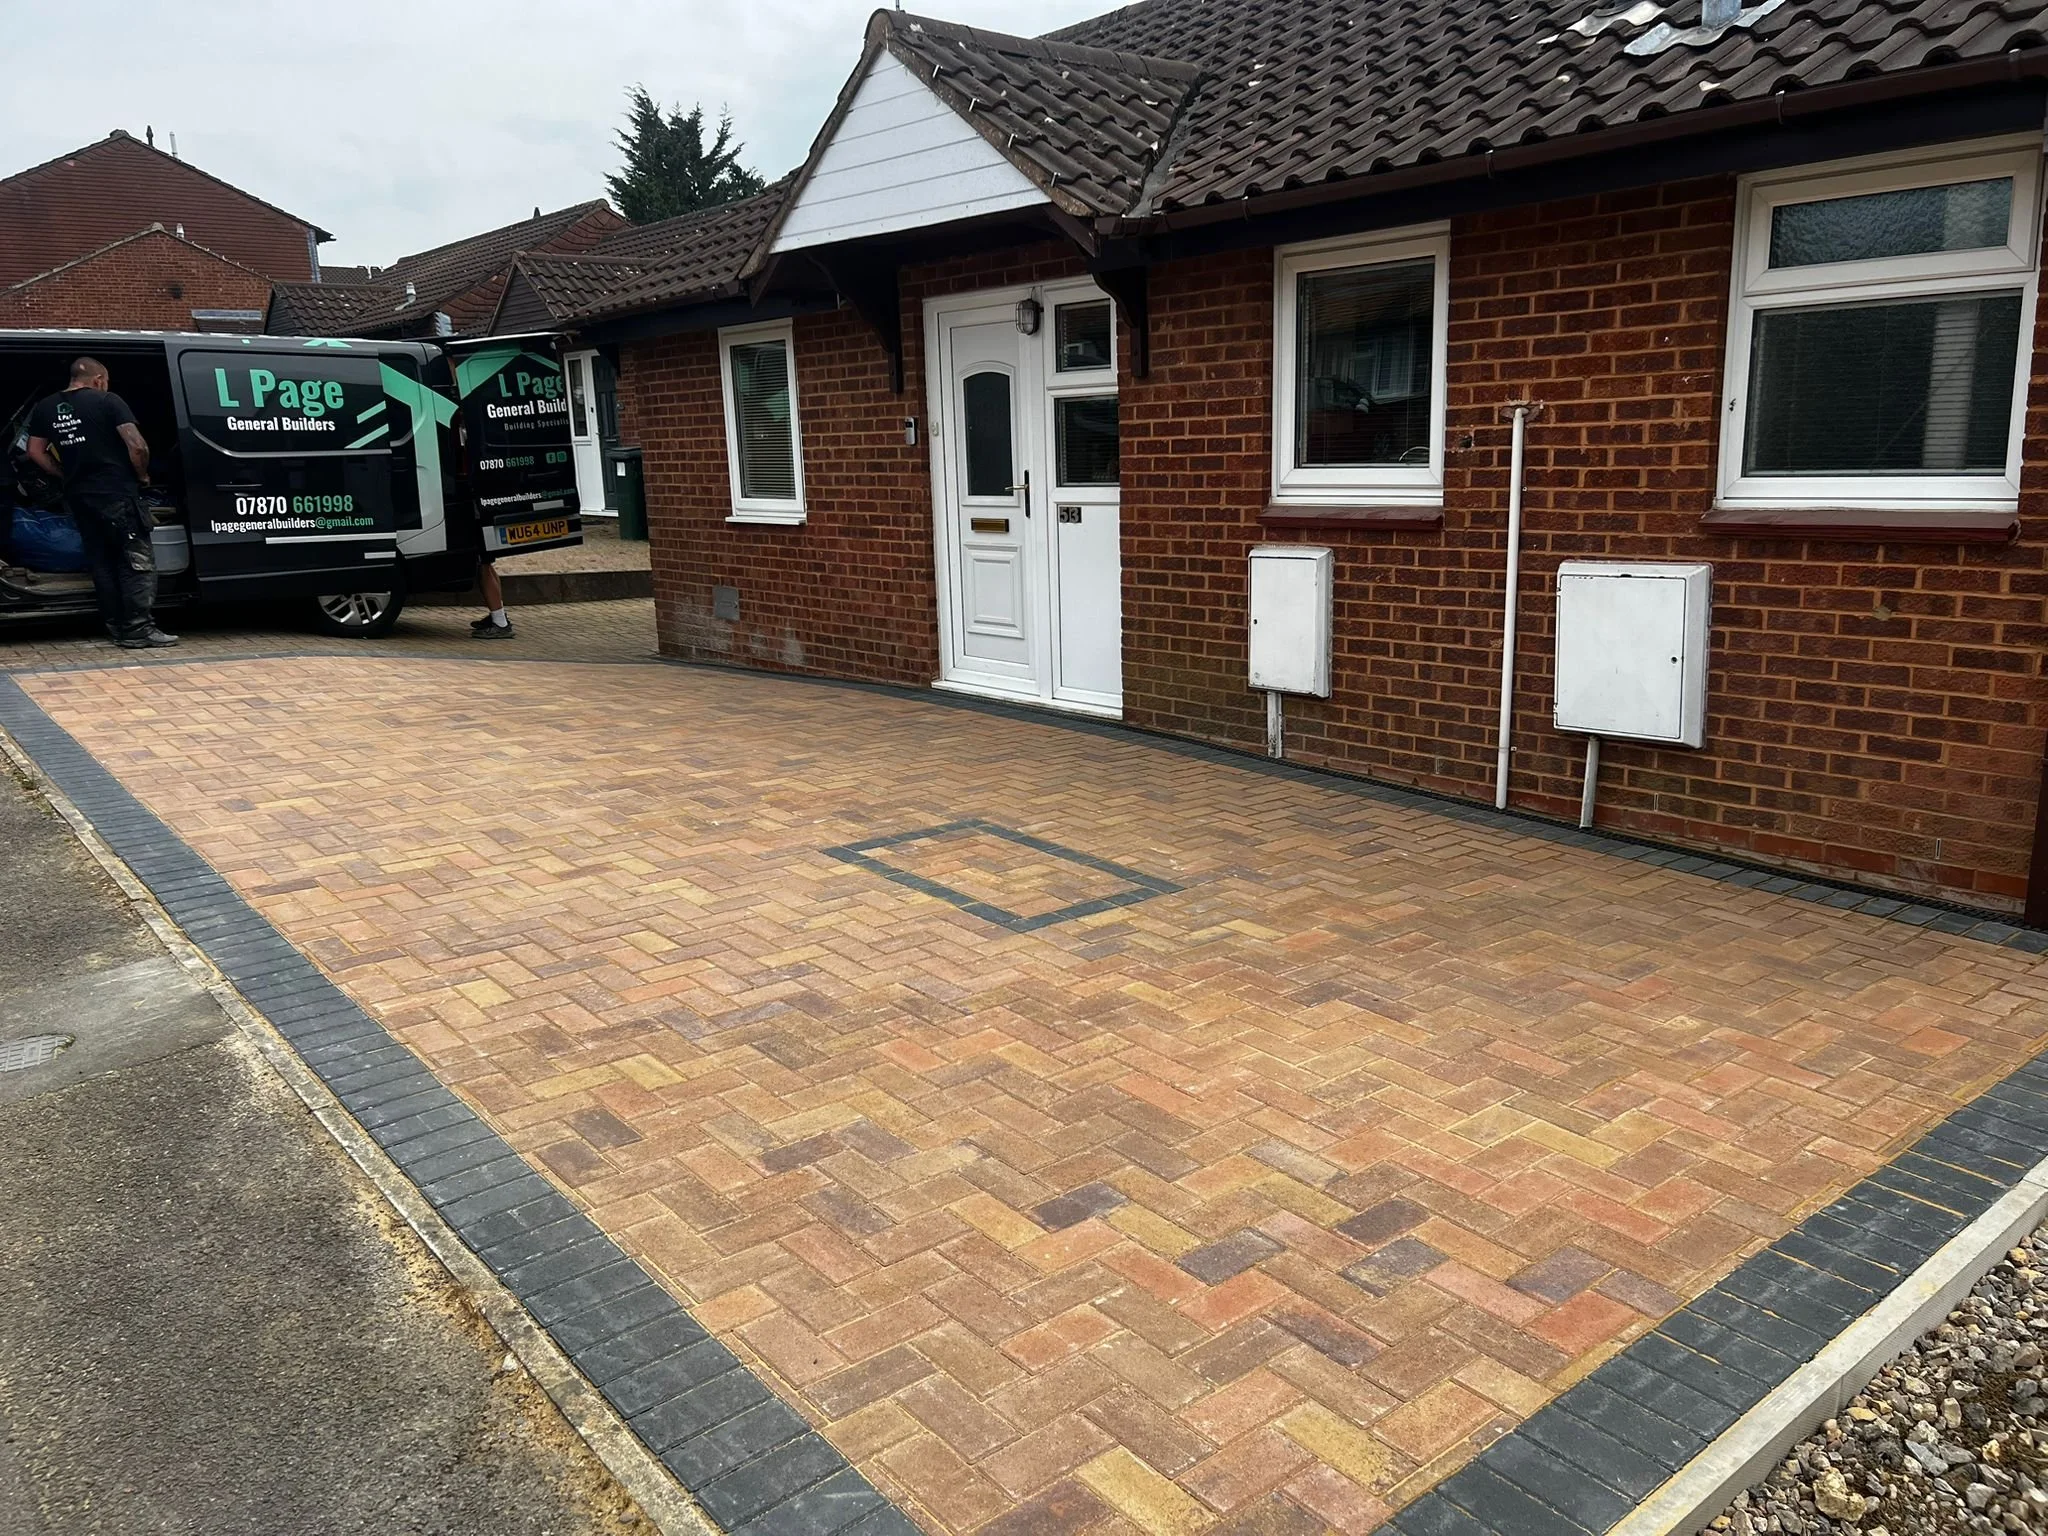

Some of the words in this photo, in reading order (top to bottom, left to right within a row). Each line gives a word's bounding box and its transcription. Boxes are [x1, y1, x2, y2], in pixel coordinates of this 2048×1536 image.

[214, 368, 240, 407] L
[249, 369, 344, 417] Page
[498, 373, 512, 398] L
[486, 400, 535, 419] General
[227, 416, 279, 431] General
[282, 417, 336, 432] Builders
[504, 421, 535, 431] Building
[479, 458, 504, 470] 07870
[505, 455, 535, 468] 661998
[235, 496, 287, 515] 07870
[292, 494, 354, 514] 661998
[1058, 506, 1079, 523] 53
[210, 516, 374, 534] lpagegeneralbuilders@gmail.com
[507, 525, 540, 540] WU64
[543, 520, 566, 535] UNP
